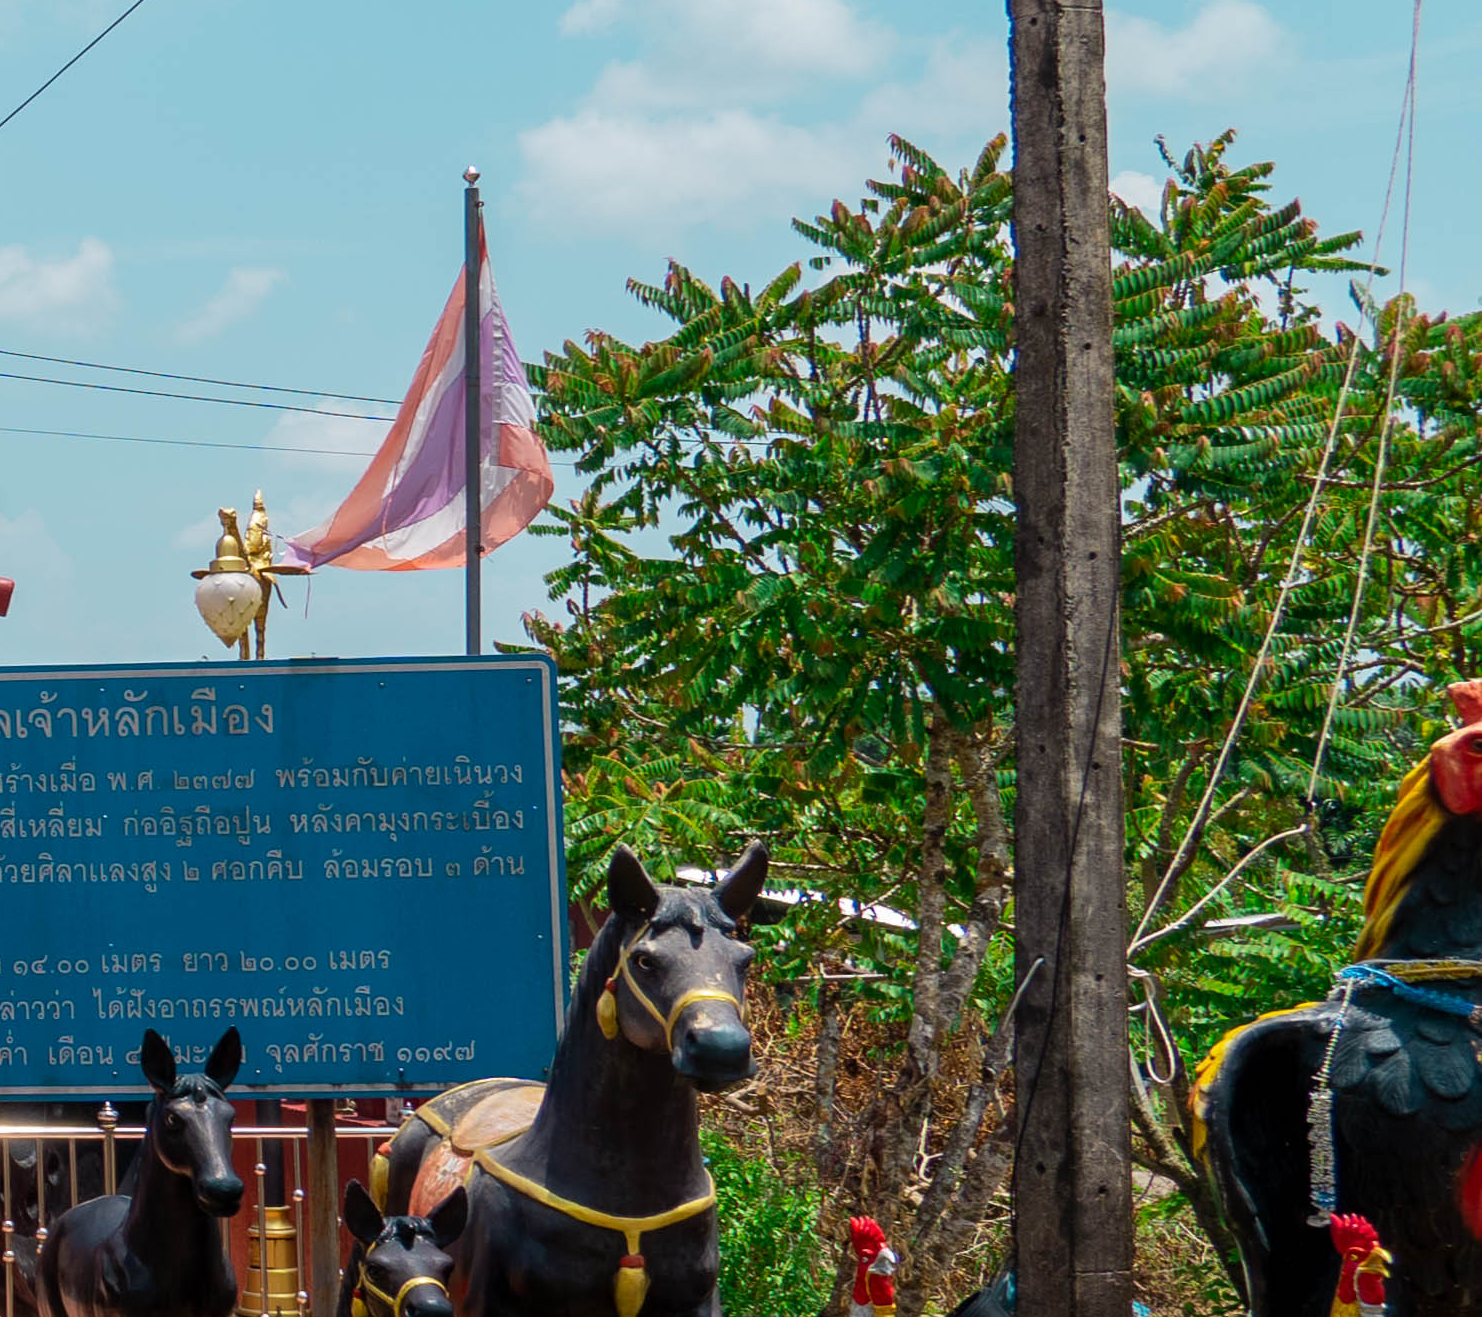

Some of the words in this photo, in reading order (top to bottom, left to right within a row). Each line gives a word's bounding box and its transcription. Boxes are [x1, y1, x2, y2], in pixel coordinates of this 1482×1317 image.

[173, 769, 256, 790] ๒๓๗๗
[275, 755, 523, 789] พร้อมกับค่ายเนินวง
[123, 805, 271, 847] ก่ออิฐถือปูน
[289, 790, 524, 842] หลังคามุงกระเบื้อง
[182, 862, 199, 881] ๒
[211, 848, 303, 881] ศอกคืบ
[323, 848, 434, 879] ล้อมรอบ
[445, 863, 460, 877] ๓
[472, 845, 524, 877] ด้าน
[12, 954, 90, 975] ๑๔.๐๐
[101, 949, 162, 973] เมตร
[182, 950, 229, 972] ยาว
[240, 950, 318, 972] ๒๐.๐๐
[328, 948, 391, 971] เมตร
[92, 985, 404, 1019] ได้ฝังอาถรรพณ์หลักเมือง
[48, 1035, 113, 1066] เดือน
[265, 1032, 385, 1072] จุลศักราช
[396, 1038, 476, 1061] ๑๑๙๗
